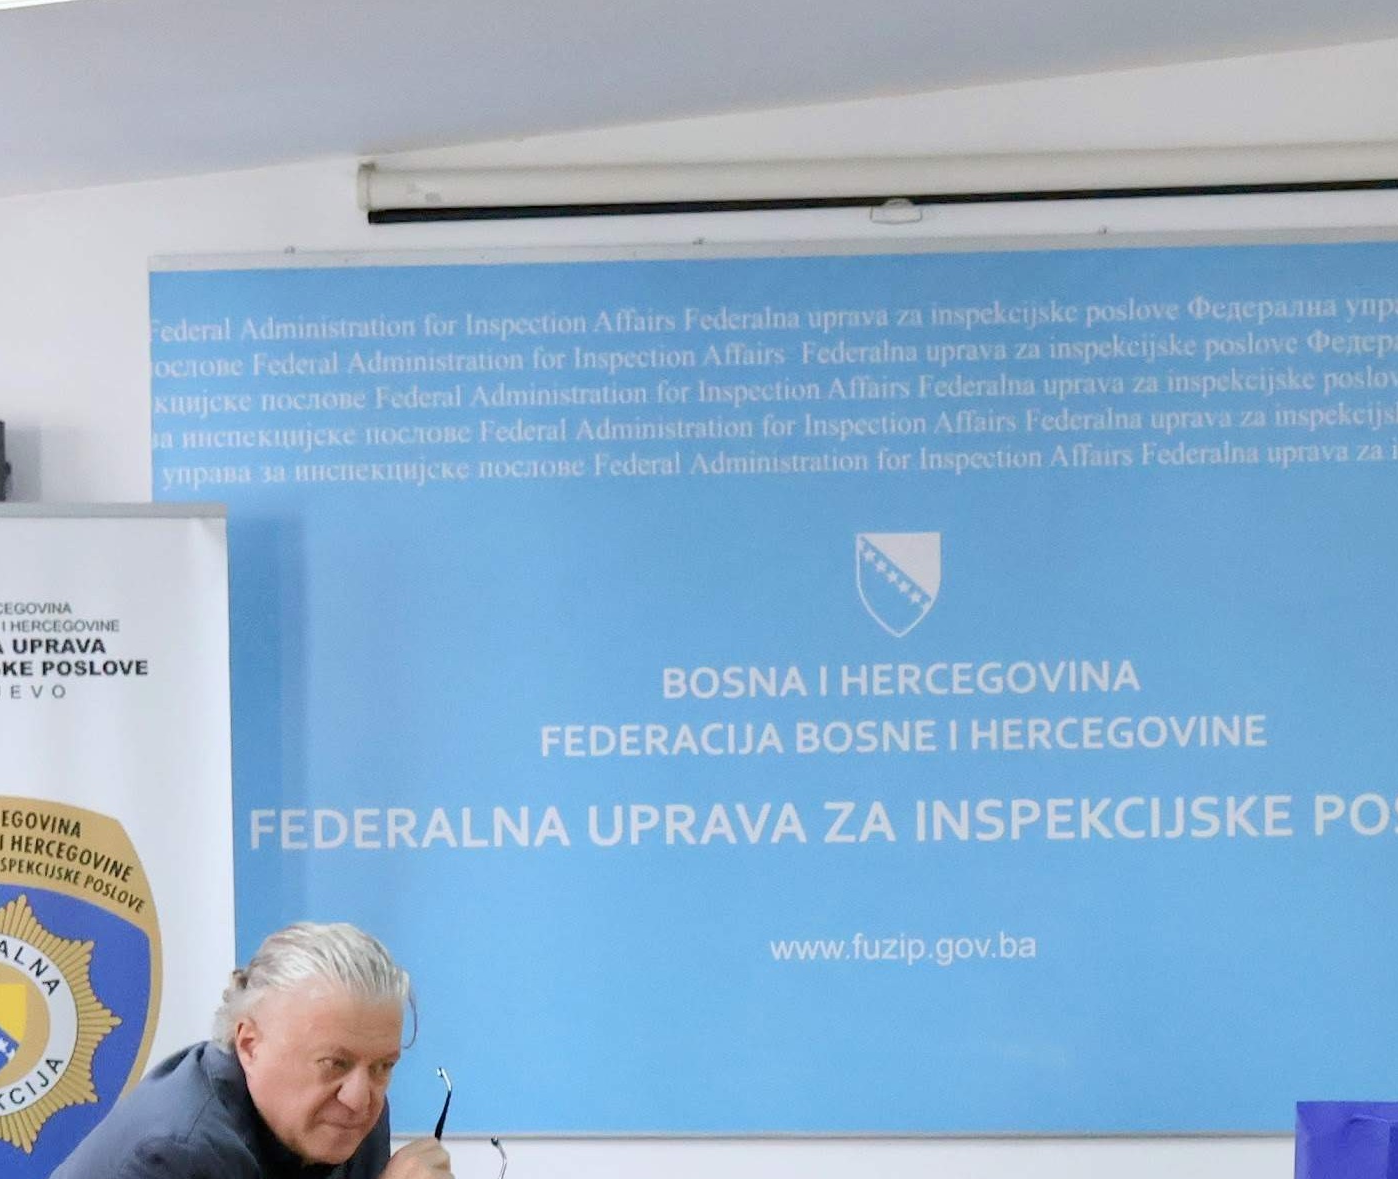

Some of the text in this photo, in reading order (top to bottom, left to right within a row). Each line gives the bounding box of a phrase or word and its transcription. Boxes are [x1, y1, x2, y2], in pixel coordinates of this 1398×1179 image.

[240, 315, 417, 341] Administration
[423, 313, 458, 338] for
[465, 312, 587, 342] Inspection
[592, 307, 677, 333] Affairs
[683, 305, 801, 332] Federalna
[807, 308, 889, 335] uprava
[896, 308, 924, 328] za
[930, 299, 1079, 331] inspekcijske
[1084, 297, 1180, 329] poslove
[1186, 294, 1338, 326] Федерална
[252, 351, 340, 377] Federal
[347, 349, 525, 375] Administration
[532, 346, 567, 370] for
[573, 345, 697, 376] Inspection
[702, 341, 786, 367] Affairs
[801, 338, 919, 365] Federalna
[925, 343, 1009, 368] uprava
[1014, 342, 1042, 360] za
[1049, 332, 1198, 365] inspekcijske
[1203, 331, 1299, 362] poslove
[260, 392, 366, 412] послове
[375, 383, 463, 410] Federal
[469, 382, 648, 408] Administration
[656, 379, 692, 404] for
[697, 377, 823, 409] Inspection
[826, 374, 911, 400] Affairs
[917, 372, 1036, 399] Federalna
[1043, 376, 1125, 401] uprava
[1131, 375, 1160, 395] za
[1166, 366, 1316, 399] inspekcijske
[181, 427, 357, 453] инспекцијске
[365, 425, 473, 445] послове
[479, 417, 567, 444] Federal
[574, 416, 754, 441] Administration
[761, 412, 797, 439] for
[804, 412, 928, 442] Inspection
[933, 409, 1018, 435] Affairs
[1025, 407, 1143, 433] Federalna
[1150, 410, 1233, 436] uprava
[1240, 410, 1267, 428] za
[162, 465, 253, 491] управа
[261, 465, 287, 484] за
[294, 461, 471, 487] инспекцијске
[477, 458, 586, 479] послове
[593, 451, 682, 477] Federal
[689, 450, 870, 476] Administration
[876, 446, 912, 473] for
[919, 446, 1043, 476] Inspection
[1050, 442, 1135, 468] Affairs
[1141, 440, 1260, 466] Federalna
[1266, 444, 1350, 469] uprava
[1356, 443, 1385, 462] za
[1, 620, 7, 632] I
[9, 619, 120, 633] HERCEGOVINE
[12, 638, 106, 655] UPRAVA
[41, 660, 148, 677] POSLOVE
[662, 659, 1142, 700] BOSNA I HERCEGOVINA
[540, 714, 1268, 758] FEDERACIJA BOSNE I HERCEGOVINE
[250, 805, 572, 851] FEDERALNA
[588, 801, 808, 847] UPRAVA
[823, 800, 897, 844] ZA
[916, 794, 1294, 842] INSPEKCIJSKE
[0, 834, 4, 851] I
[11, 835, 133, 883] HERCEGOVINE
[83, 875, 146, 914] POSLOVE
[769, 930, 1038, 967] www.fuzip.gov.ba
